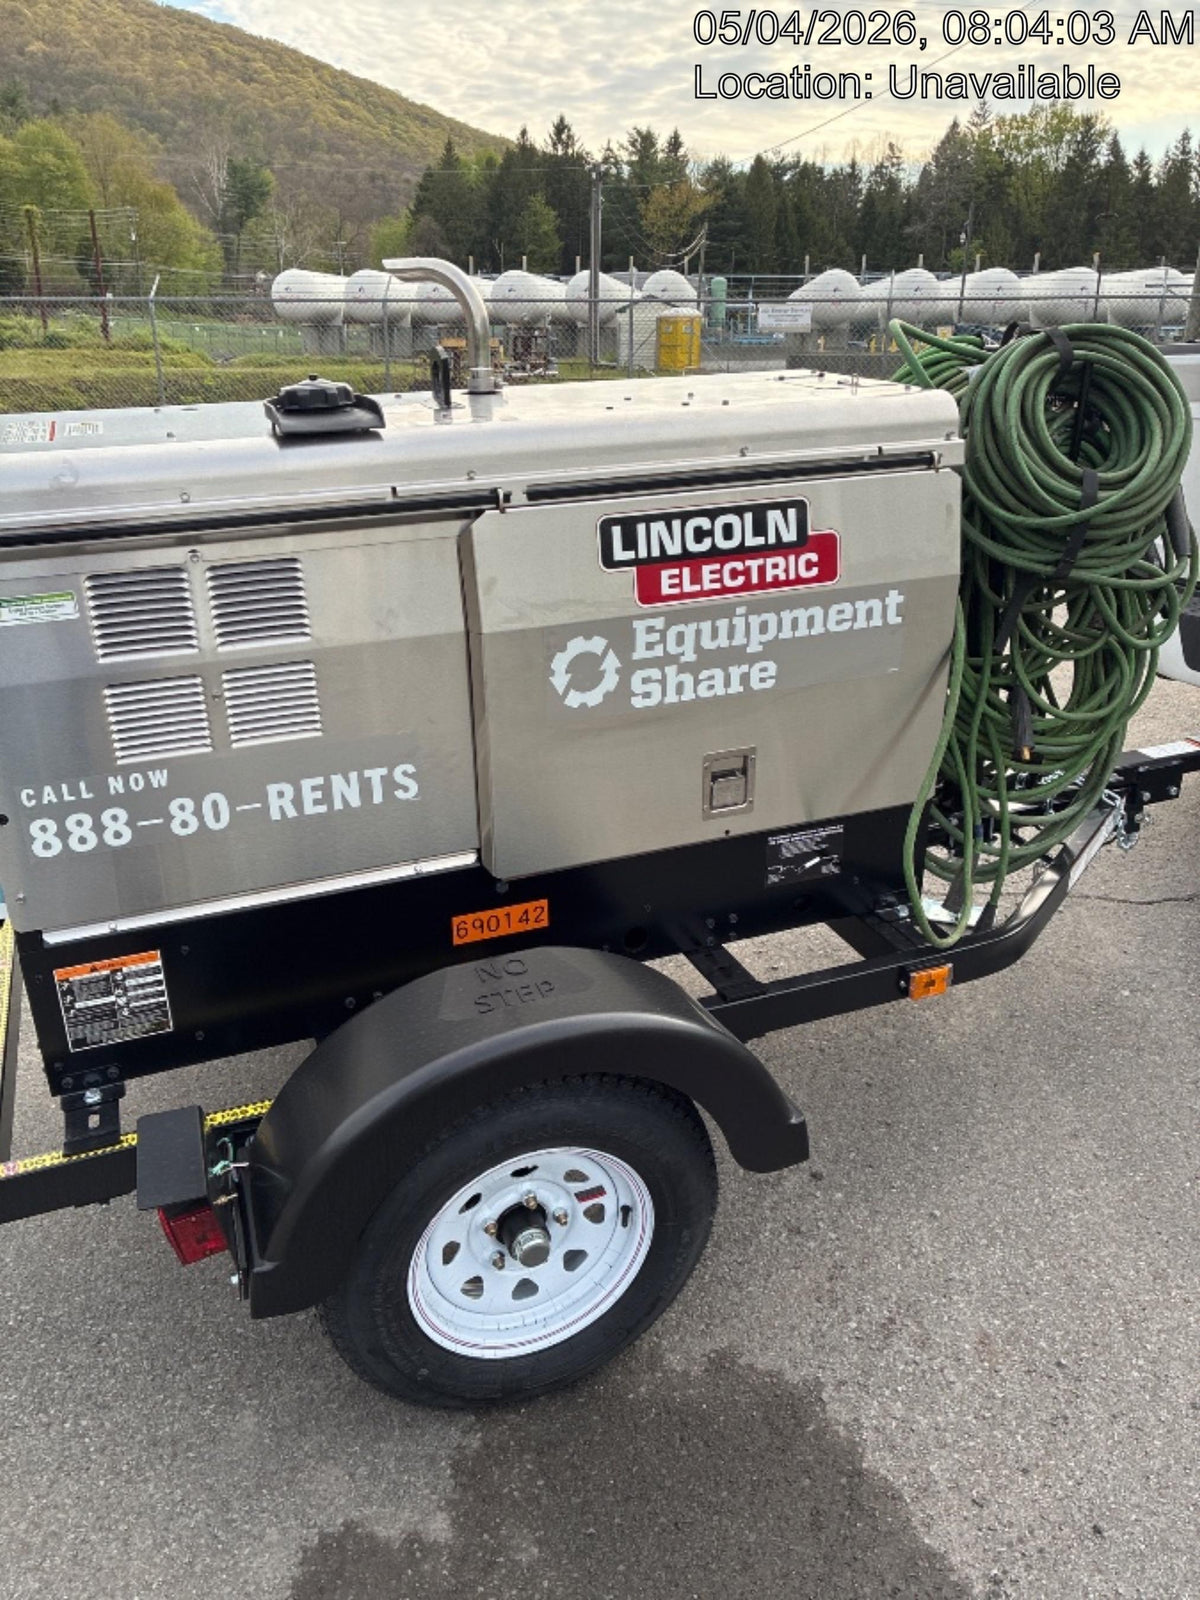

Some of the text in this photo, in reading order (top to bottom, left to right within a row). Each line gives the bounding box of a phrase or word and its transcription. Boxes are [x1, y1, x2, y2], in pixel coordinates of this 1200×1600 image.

[611, 507, 798, 562] LINCOLN
[660, 552, 819, 596] ELECTRIC
[631, 589, 905, 663] Equipment
[630, 660, 778, 709] Share
[20, 768, 170, 808] CALL NOW
[28, 763, 420, 858] 888-80-RENTS
[456, 905, 546, 940] 690142
[474, 959, 529, 984] NO
[474, 980, 555, 1015] STEP
